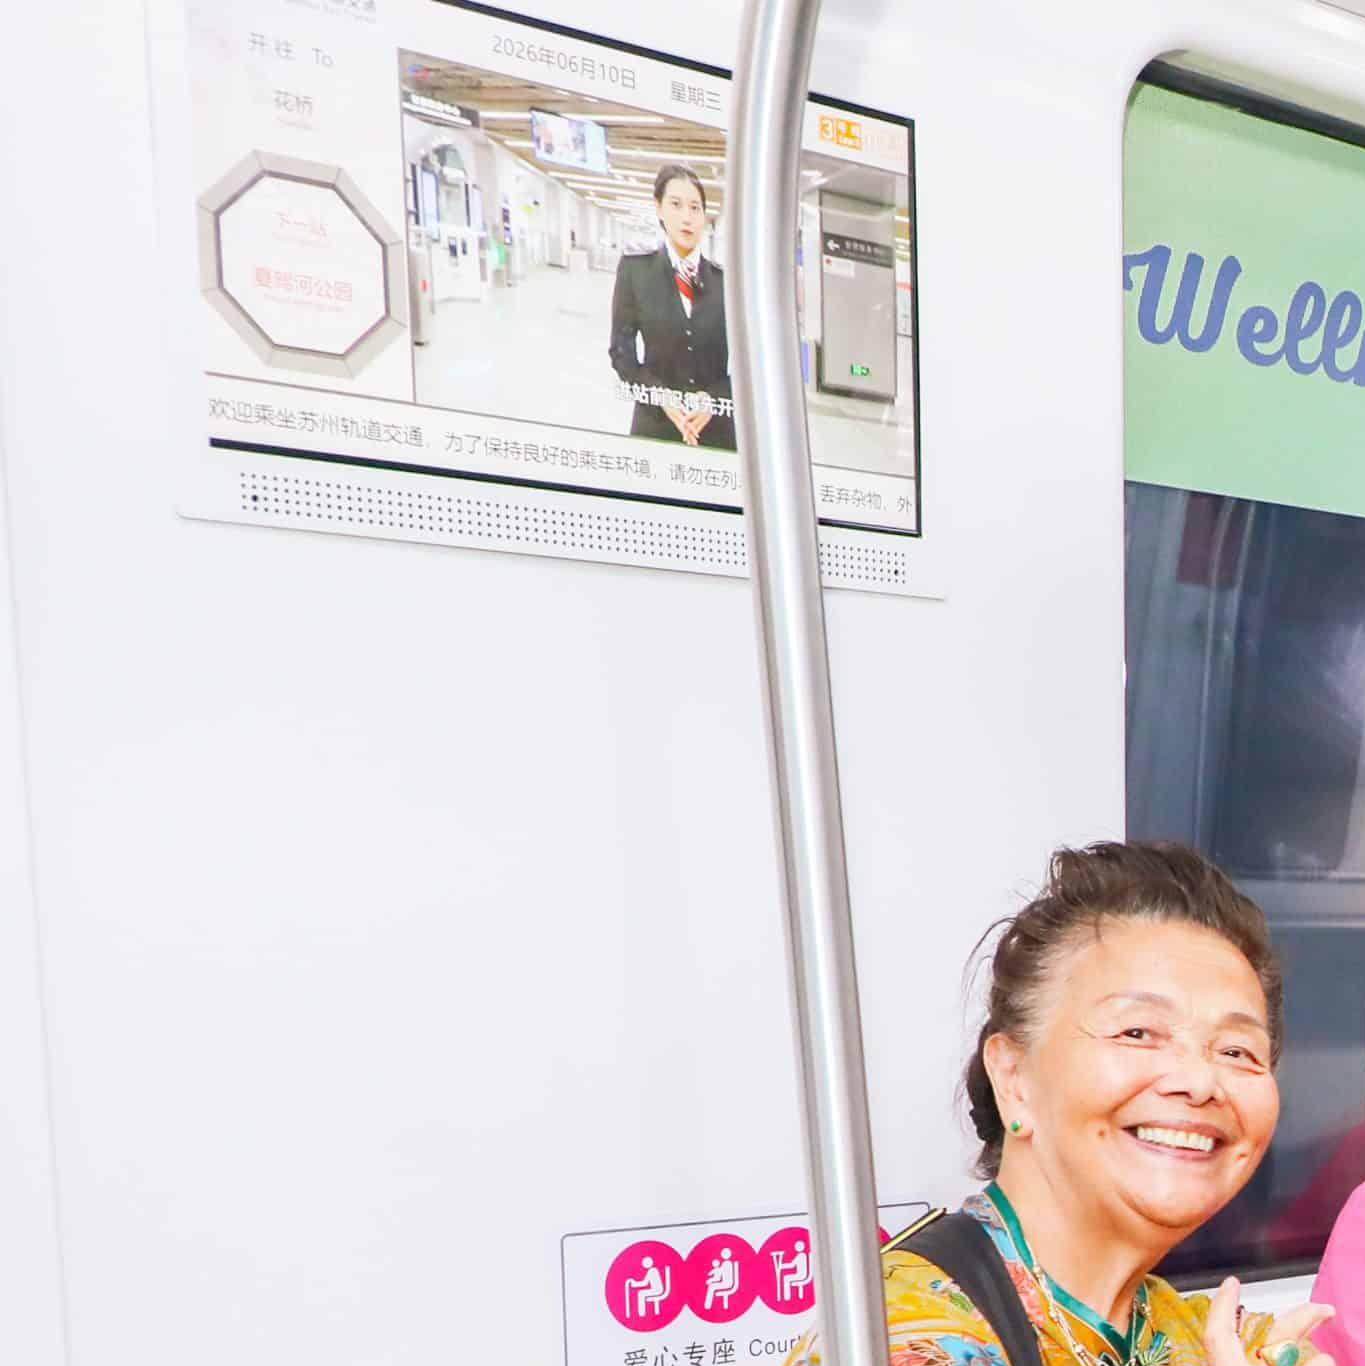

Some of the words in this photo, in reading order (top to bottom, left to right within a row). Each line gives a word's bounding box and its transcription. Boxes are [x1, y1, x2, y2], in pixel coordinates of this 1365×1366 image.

[312, 48, 333, 66] To
[492, 35, 636, 90] 2026年06月10日
[671, 80, 722, 112] 星期三
[749, 1335, 800, 1358] Cour
